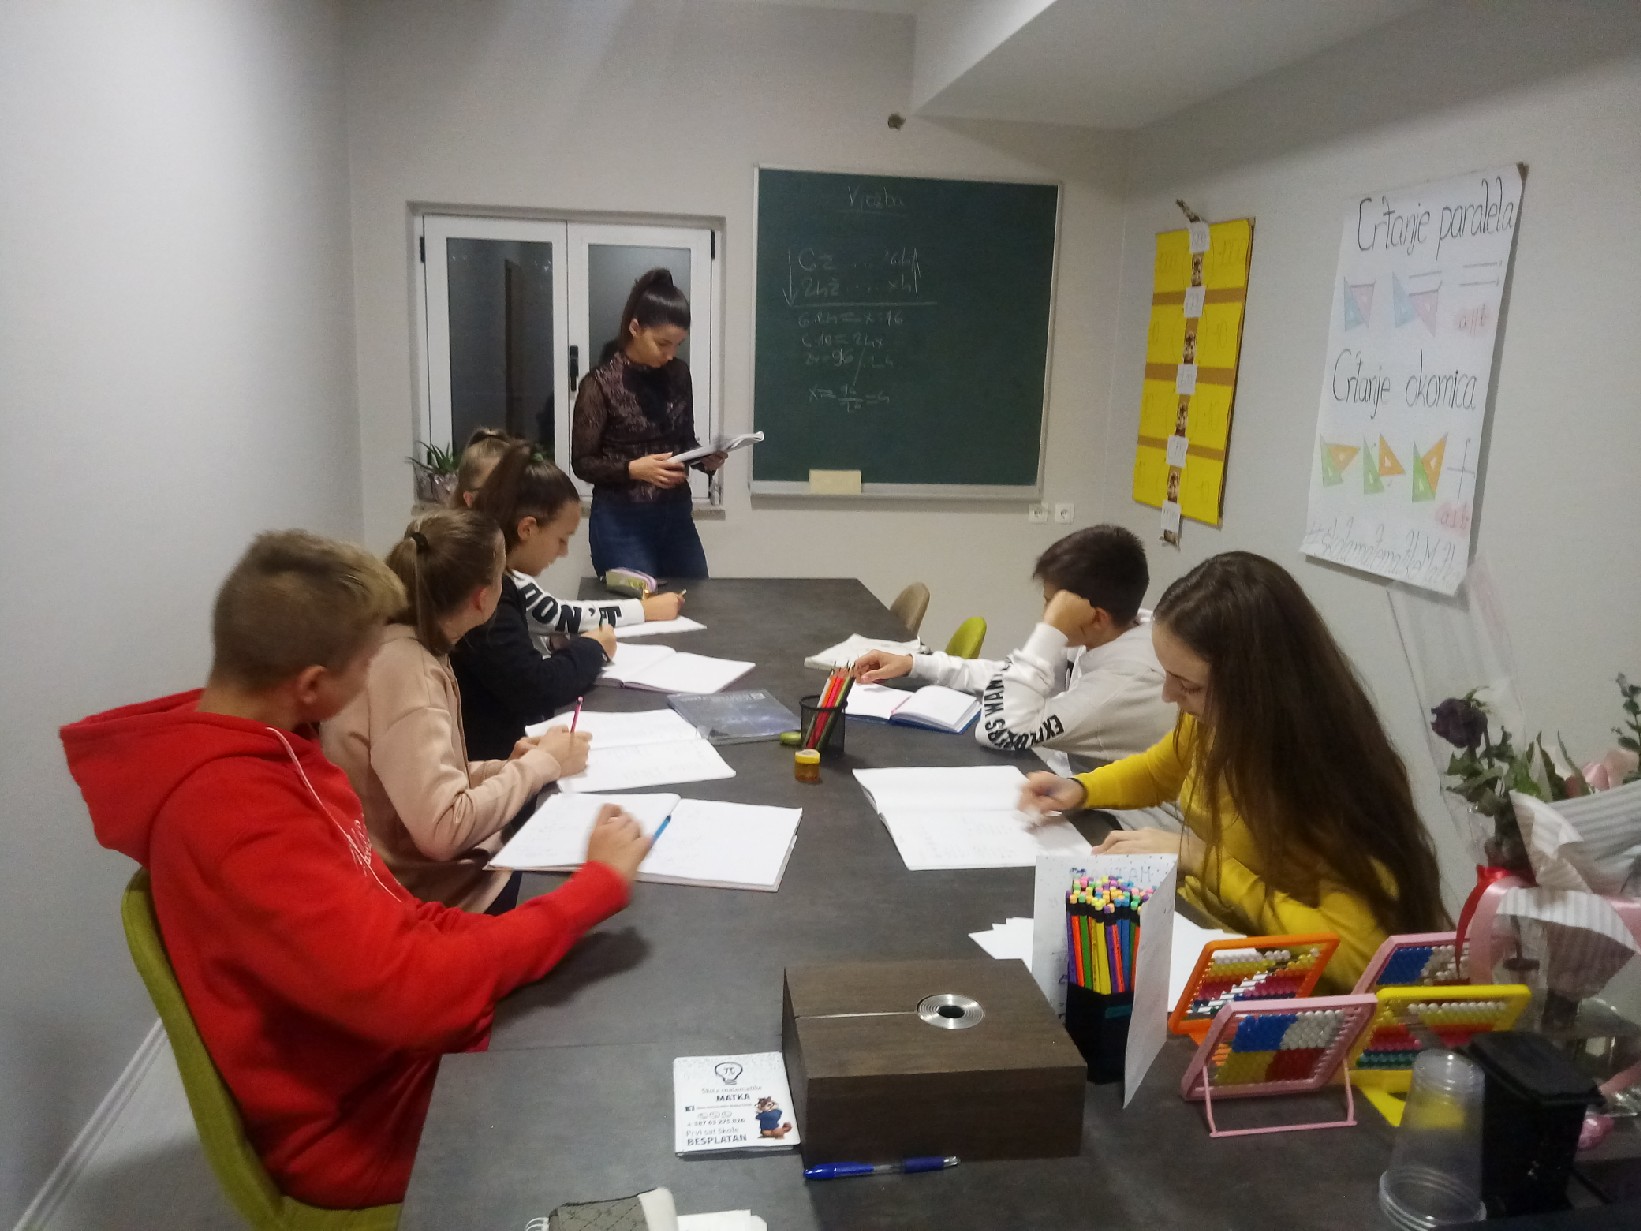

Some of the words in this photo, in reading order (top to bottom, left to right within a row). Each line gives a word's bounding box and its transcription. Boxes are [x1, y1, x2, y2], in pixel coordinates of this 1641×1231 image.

[1357, 195, 1431, 256] Crtanje
[1435, 176, 1514, 261] paralela
[1332, 348, 1391, 420] Crtanje
[1405, 348, 1478, 410] okomica
[716, 1093, 751, 1102] MATKA
[686, 1134, 748, 1146] BESPLATAN
